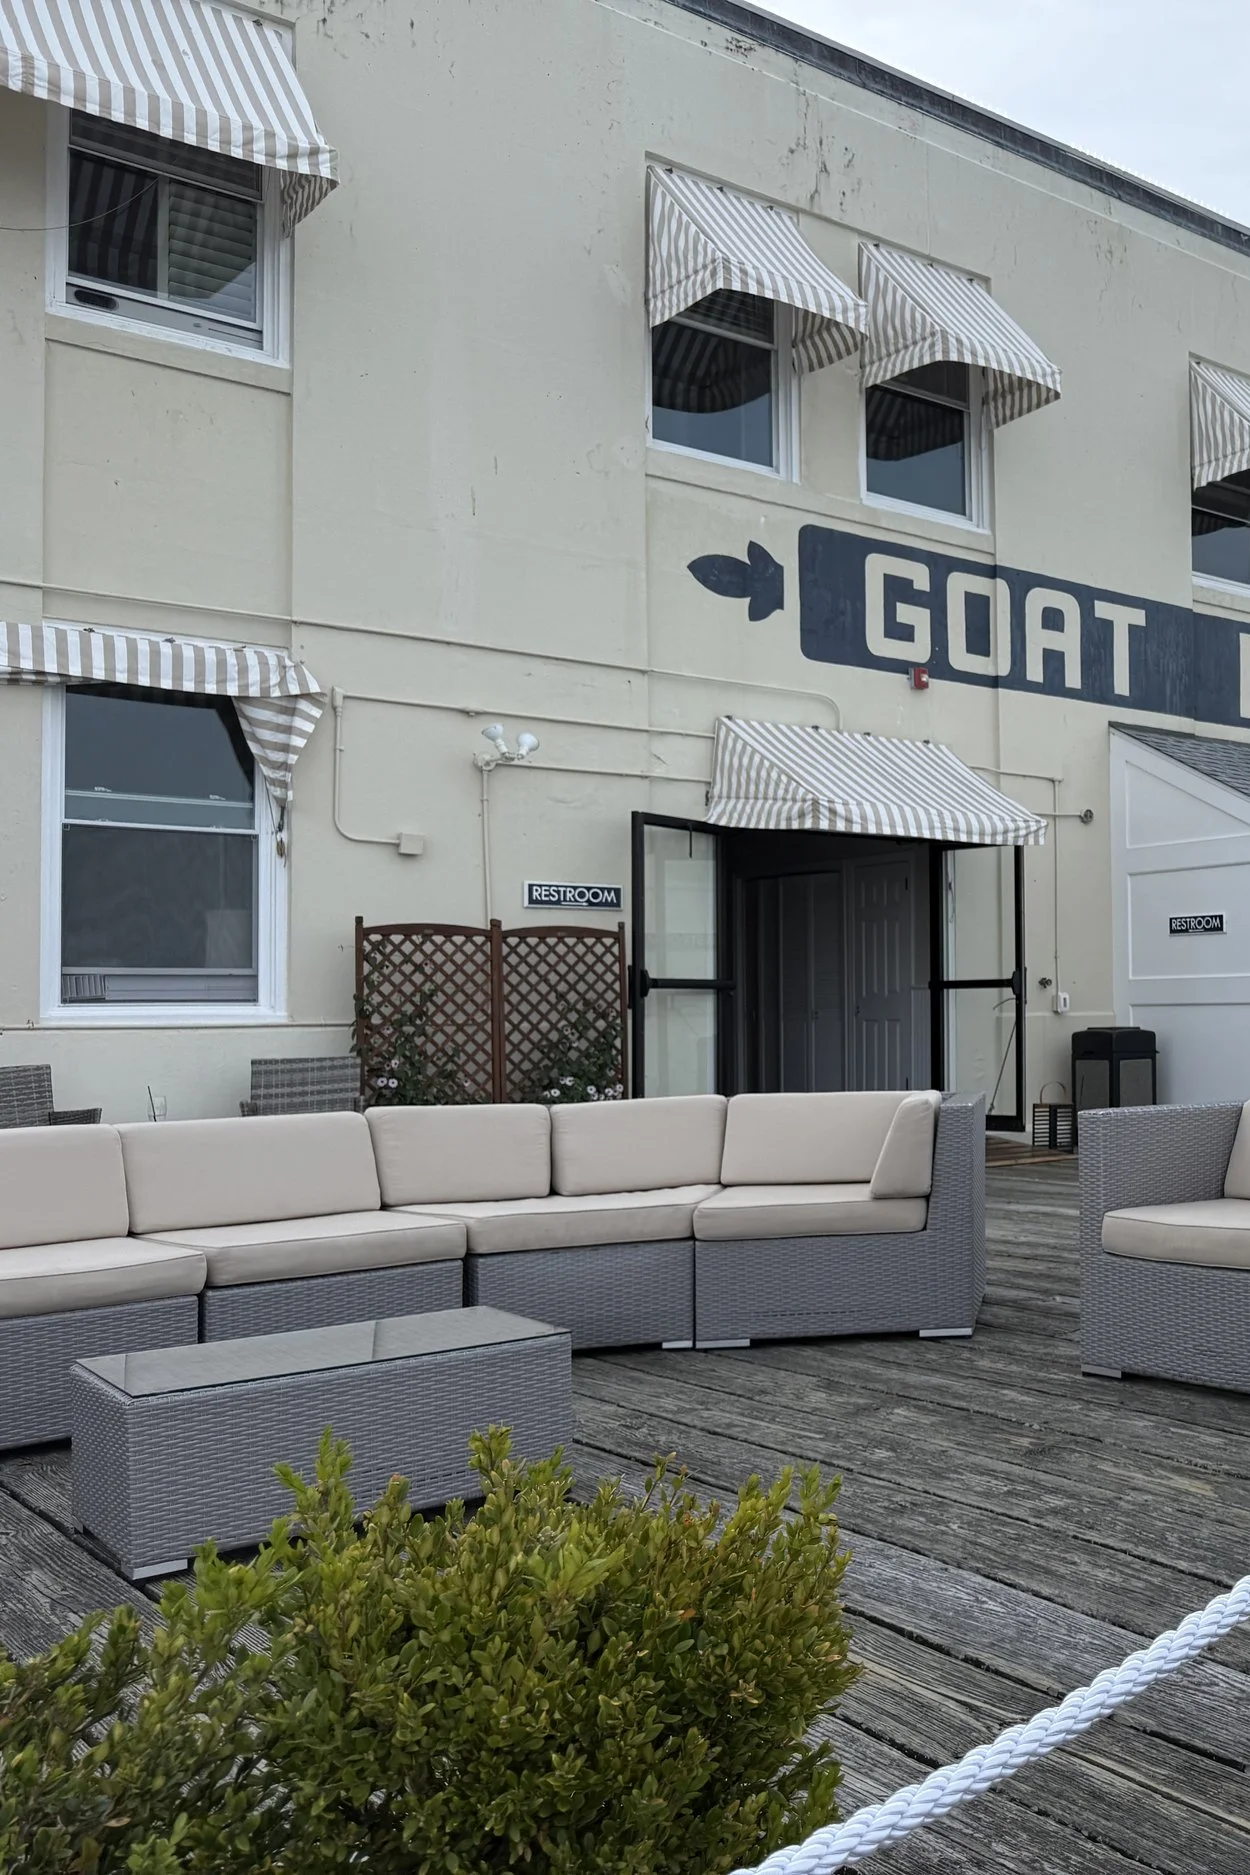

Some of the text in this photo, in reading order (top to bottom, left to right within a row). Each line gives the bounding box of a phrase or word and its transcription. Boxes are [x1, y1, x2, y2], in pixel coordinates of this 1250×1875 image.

[865, 553, 1146, 697] GOAT
[532, 886, 617, 904] RESTROOM
[1171, 916, 1221, 930] RESTROOM
